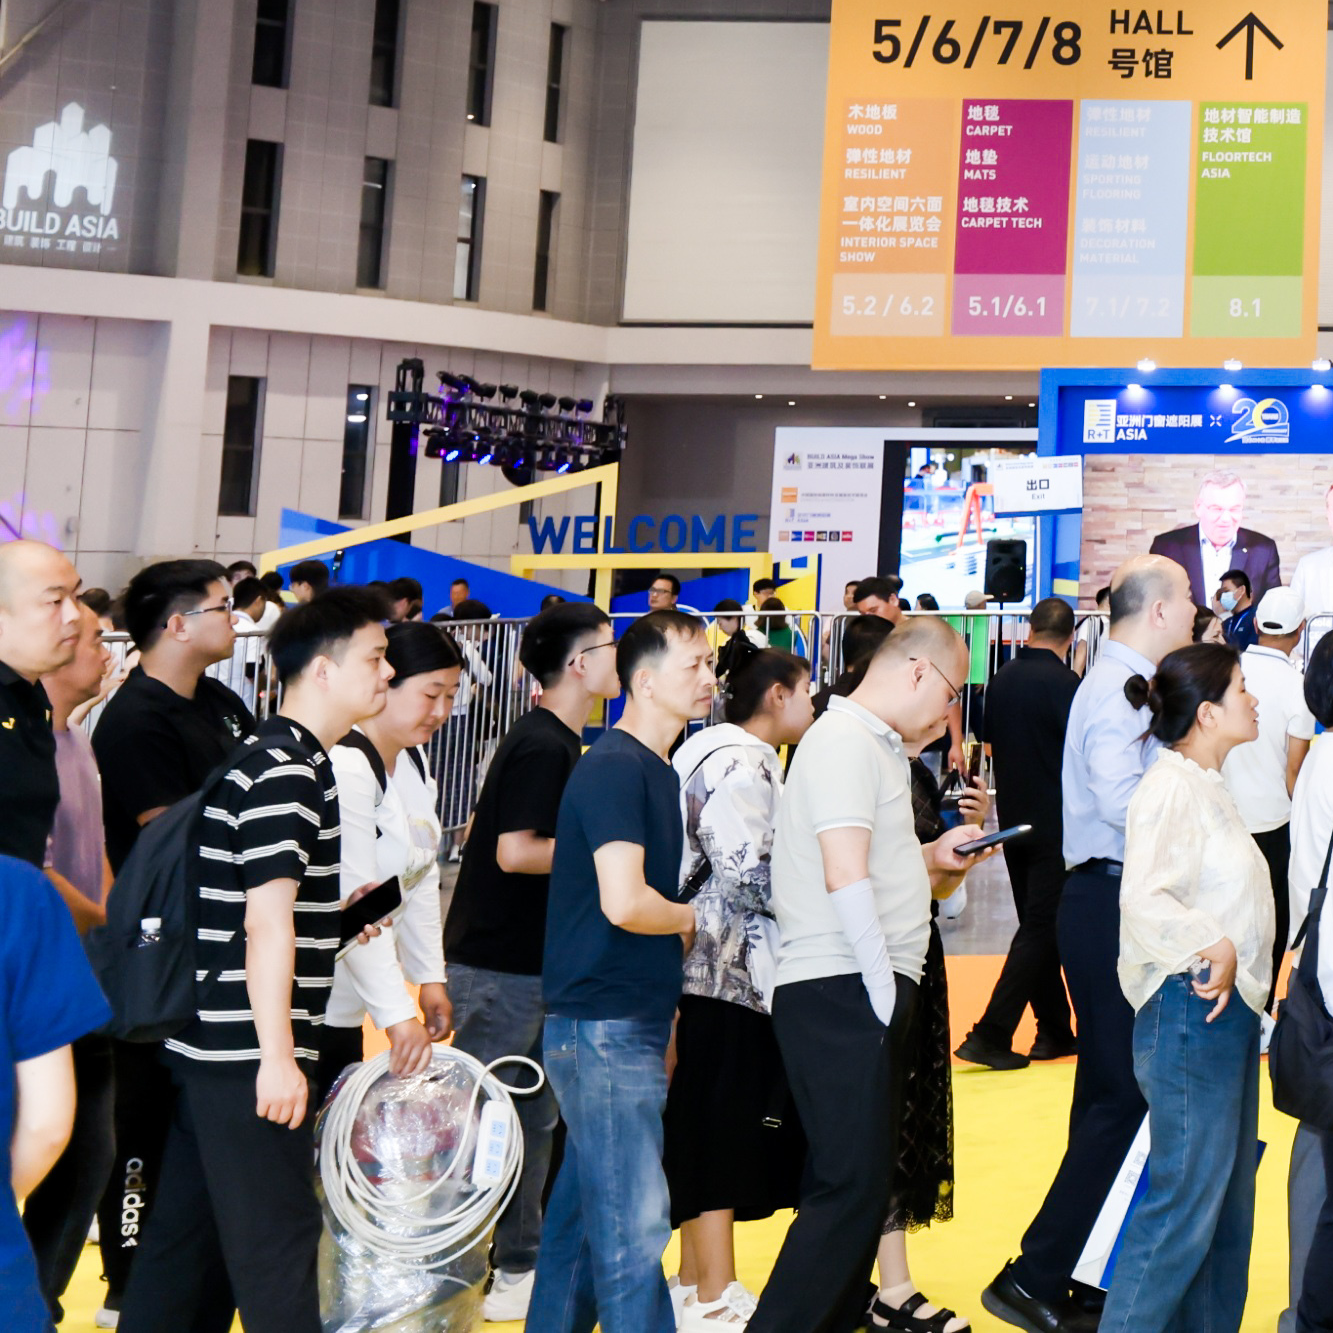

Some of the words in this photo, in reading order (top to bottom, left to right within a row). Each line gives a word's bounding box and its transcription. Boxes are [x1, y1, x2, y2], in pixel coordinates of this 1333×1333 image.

[1109, 9, 1194, 35] HALL
[872, 15, 1083, 69] 5/6/7/8
[1108, 48, 1175, 79] 号馆
[848, 105, 898, 121] 木地板
[967, 105, 1000, 121] 地毯
[1086, 106, 1152, 123] 弹性地材
[1204, 108, 1302, 125] 地材智能制造
[847, 124, 883, 136] WOOD
[966, 124, 1013, 137] CARPET
[1085, 127, 1147, 138] RESILIENT
[1203, 127, 1252, 144] 技术馆
[845, 148, 912, 165] 弹性地材
[965, 149, 999, 166] 地垫
[1202, 151, 1272, 163] FLOORTECH
[844, 168, 907, 180] RESILIENT
[964, 169, 997, 181] MATS
[1083, 174, 1142, 185] SPORTING
[1201, 168, 1231, 179] ASIA
[1083, 189, 1142, 200] FLOORING
[843, 195, 943, 213] 室内空间六面
[963, 196, 1029, 213] 地毯技术
[64, 213, 119, 240] ASIA
[842, 215, 942, 233] 一体化展览会
[961, 216, 1008, 229] CARPET
[1010, 216, 1043, 229] TECH
[840, 237, 896, 248] INTERIOR
[899, 237, 938, 248] SPACE
[1080, 237, 1156, 249] DECORATION
[839, 252, 876, 263] SHOW
[1080, 252, 1140, 264] MATERIAL
[967, 296, 1047, 318] 5.1/6.1
[1229, 297, 1263, 318] 8.1
[1116, 414, 1203, 428] 亚洲门窗遮阳展
[1087, 429, 1110, 440] R+T
[1116, 428, 1148, 440] ASIA
[1026, 478, 1050, 491] 出口
[1031, 492, 1046, 500] Exit
[528, 513, 759, 555] WELCOME
[121, 1157, 147, 1237] adidas
